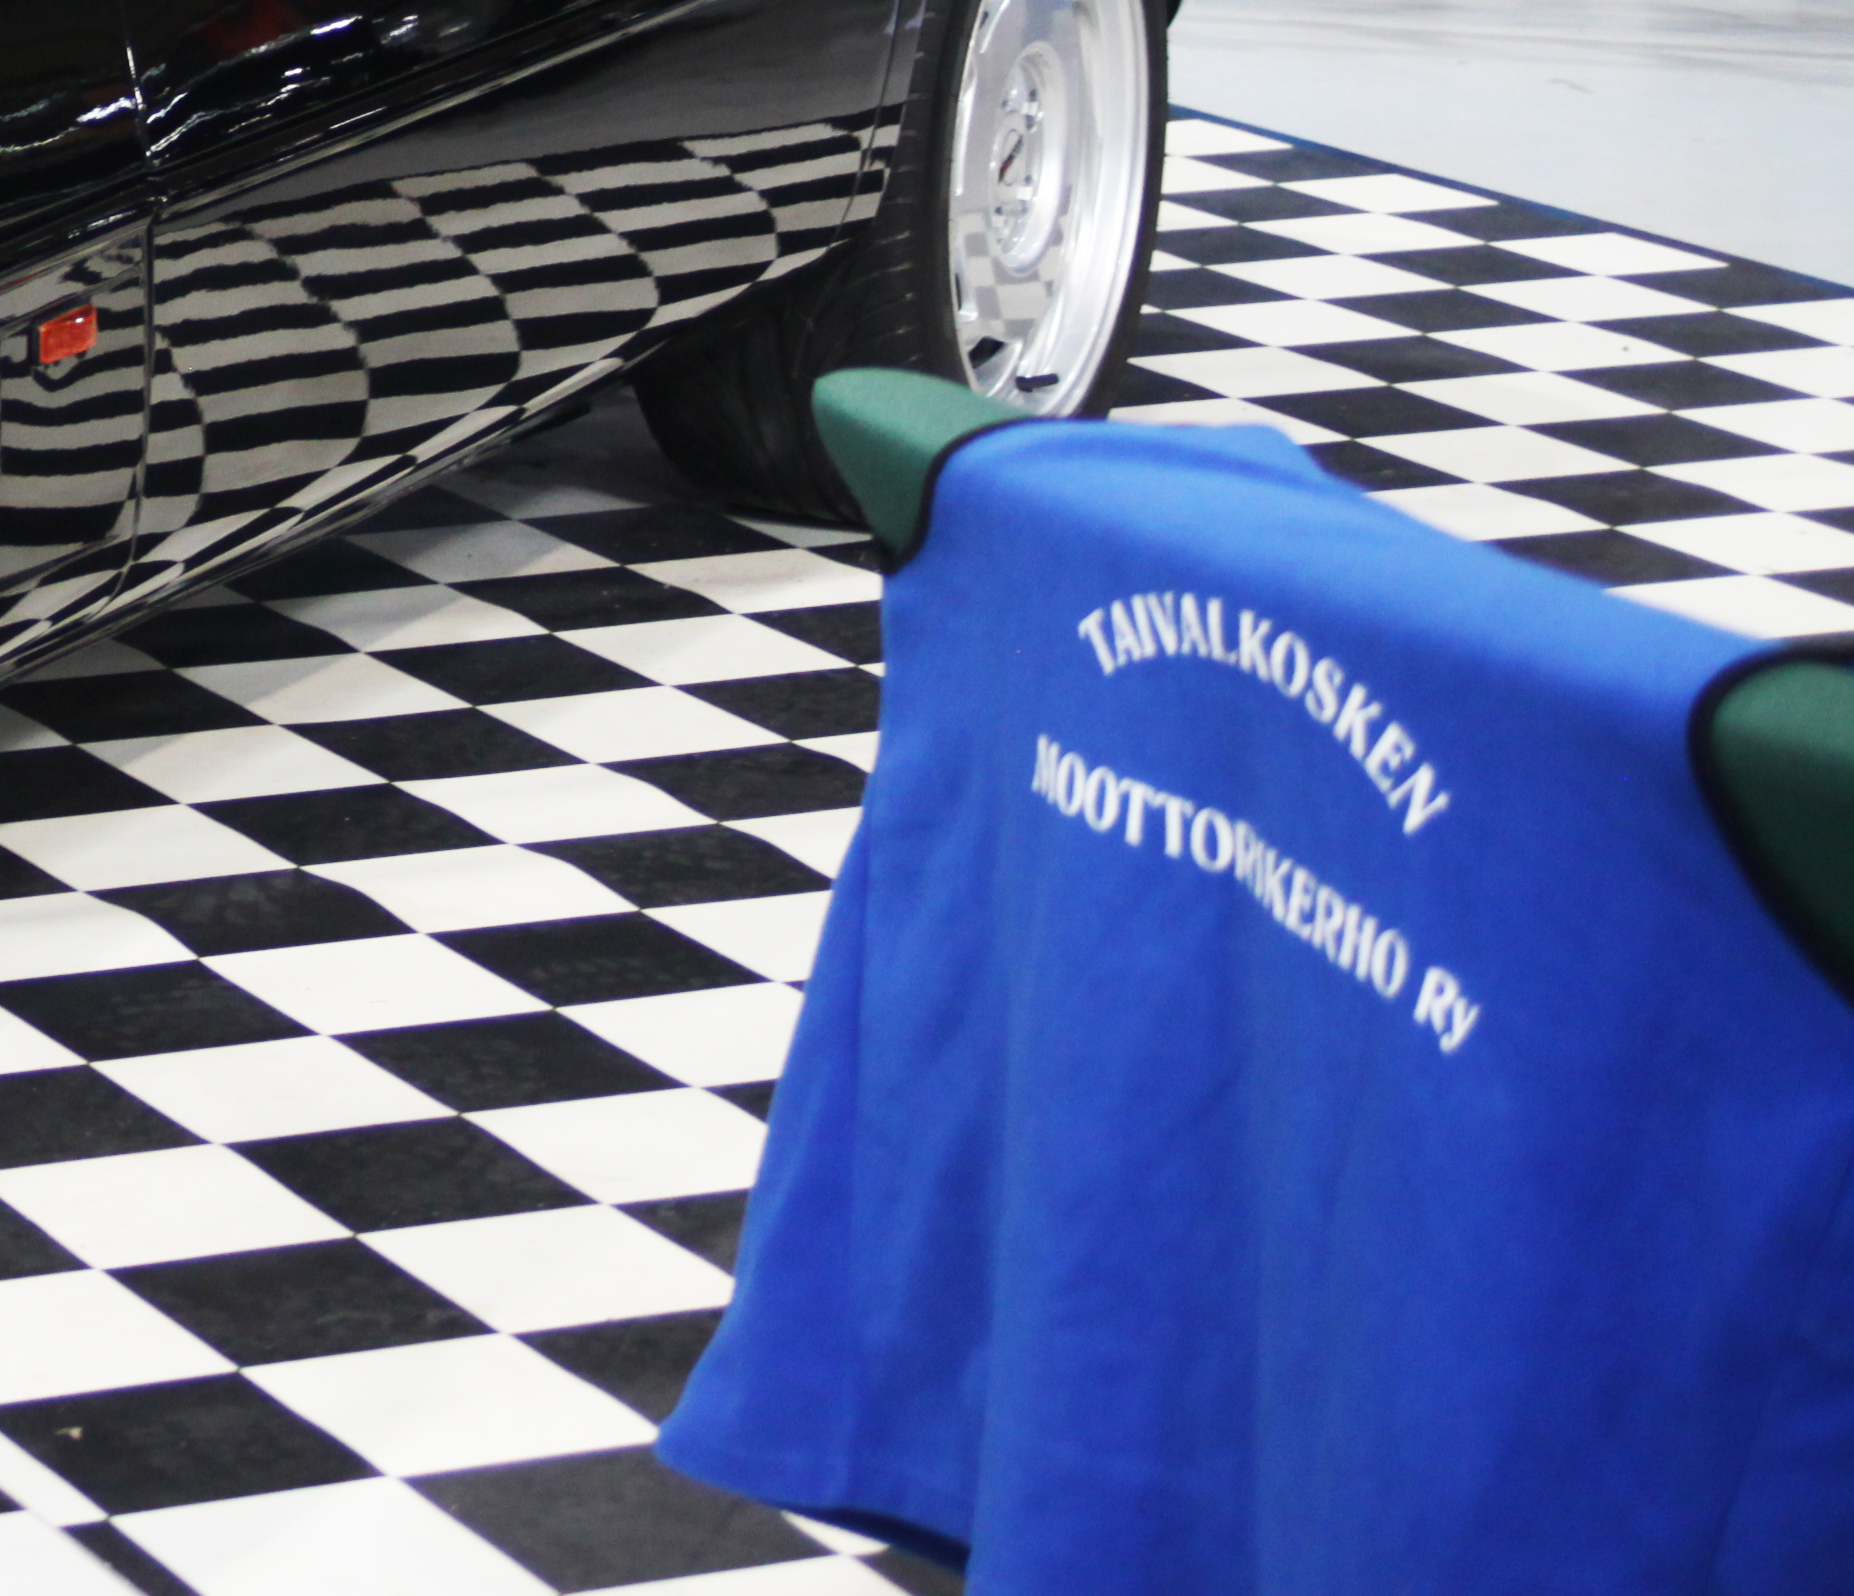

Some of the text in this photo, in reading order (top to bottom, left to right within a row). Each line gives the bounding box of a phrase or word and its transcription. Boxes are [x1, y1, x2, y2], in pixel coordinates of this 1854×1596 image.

[1078, 591, 1451, 834] TAIVALKOSKEN
[1031, 734, 1480, 1055] MOOTTORIKERHO Ry
